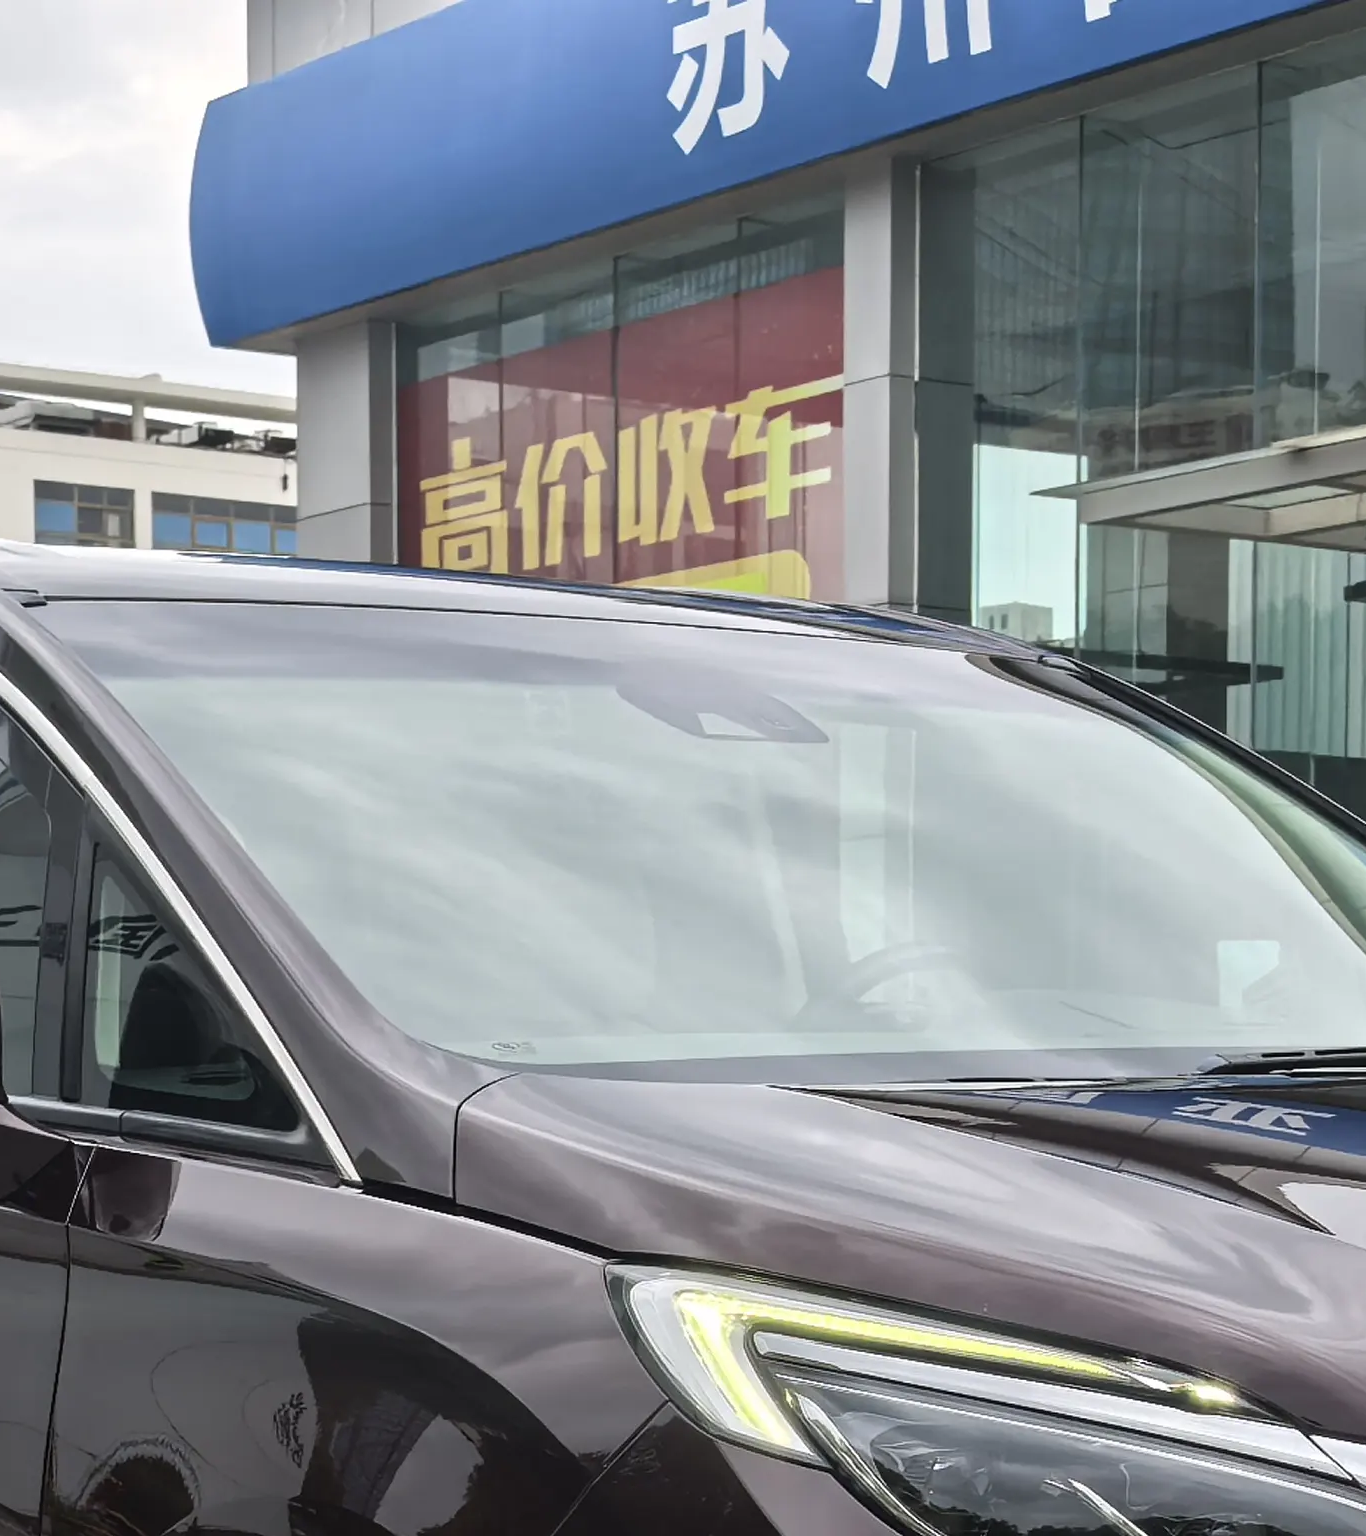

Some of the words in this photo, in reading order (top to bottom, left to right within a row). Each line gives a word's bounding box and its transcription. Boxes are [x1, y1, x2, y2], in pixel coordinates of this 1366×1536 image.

[666, 0, 1132, 155] 苏州
[420, 373, 844, 574] 高价收车
